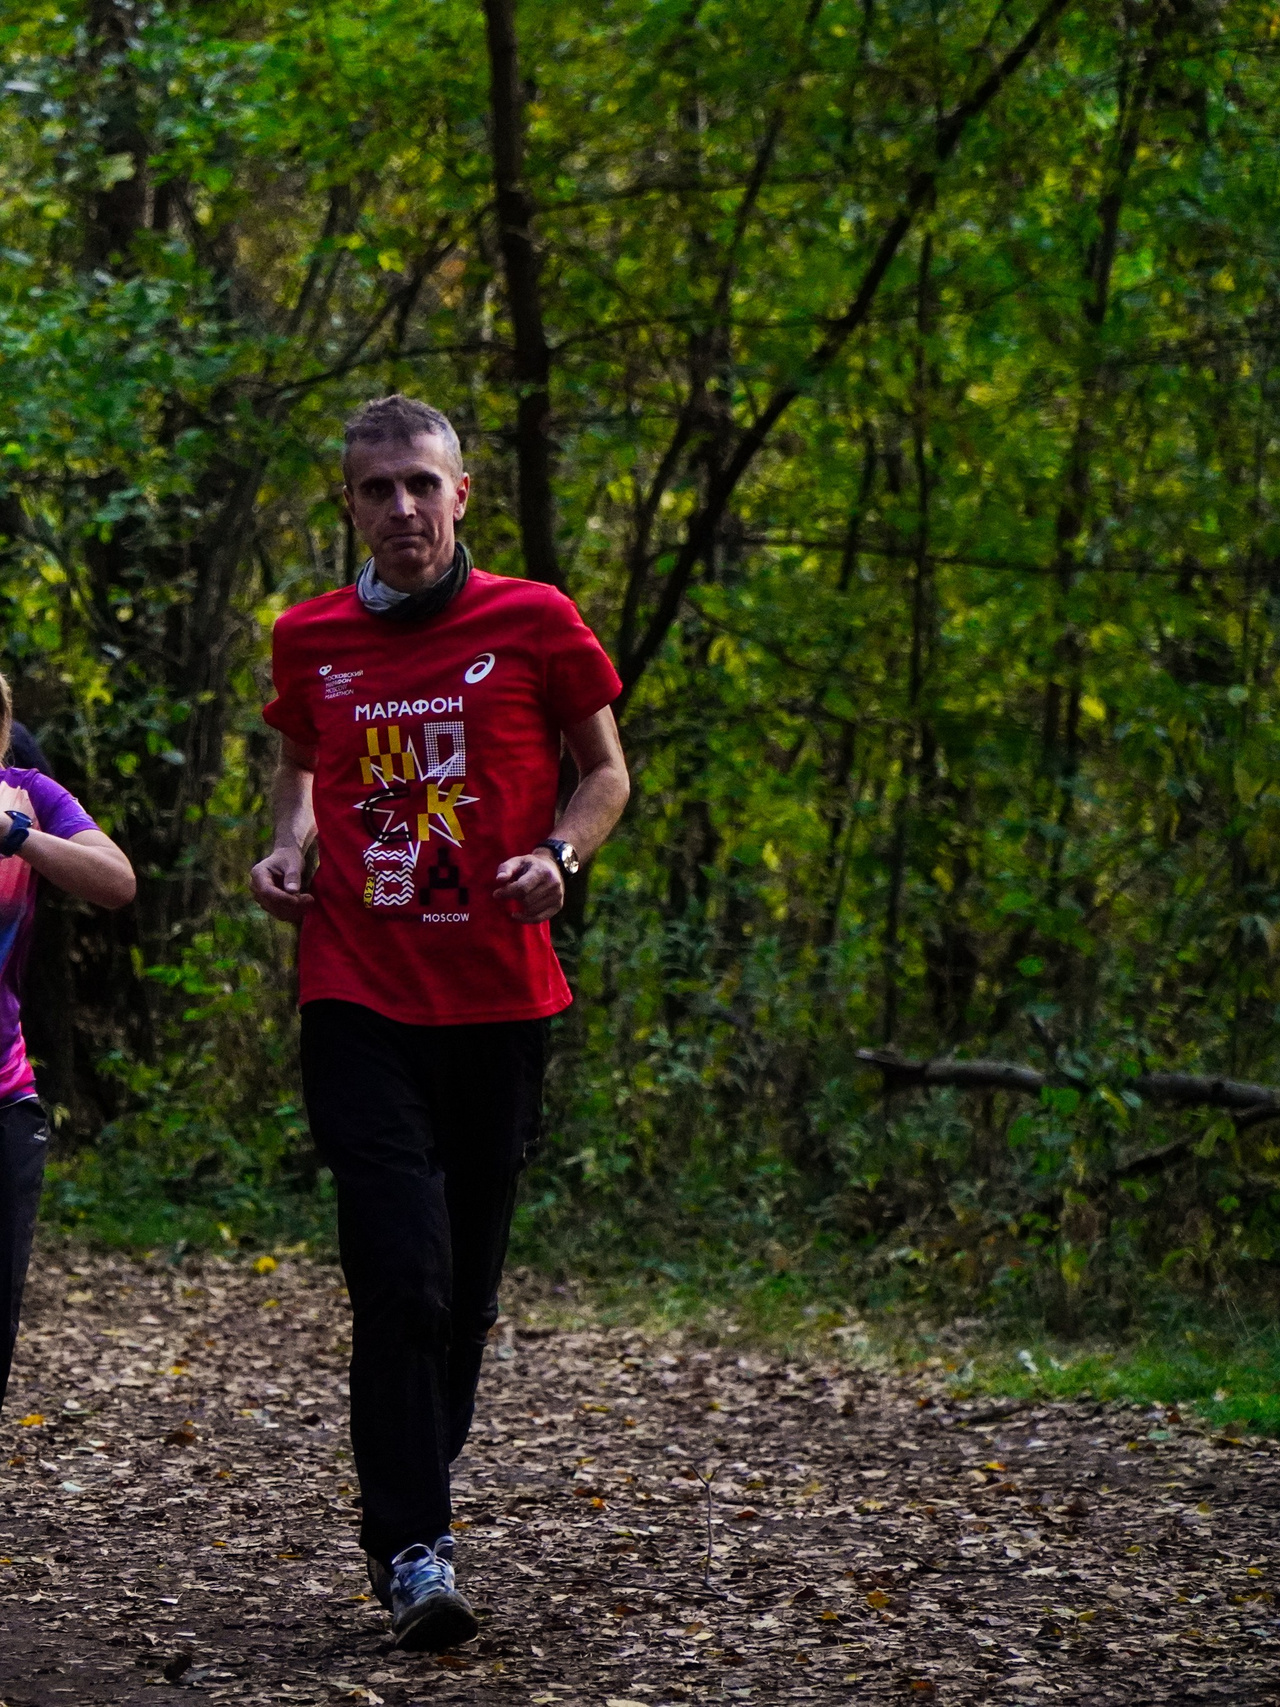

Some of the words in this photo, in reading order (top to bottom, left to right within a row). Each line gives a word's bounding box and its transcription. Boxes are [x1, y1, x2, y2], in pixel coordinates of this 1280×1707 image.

[355, 696, 463, 721] МАРАФОН
[364, 876, 375, 908] 2022
[422, 912, 470, 923] MOSCOW
